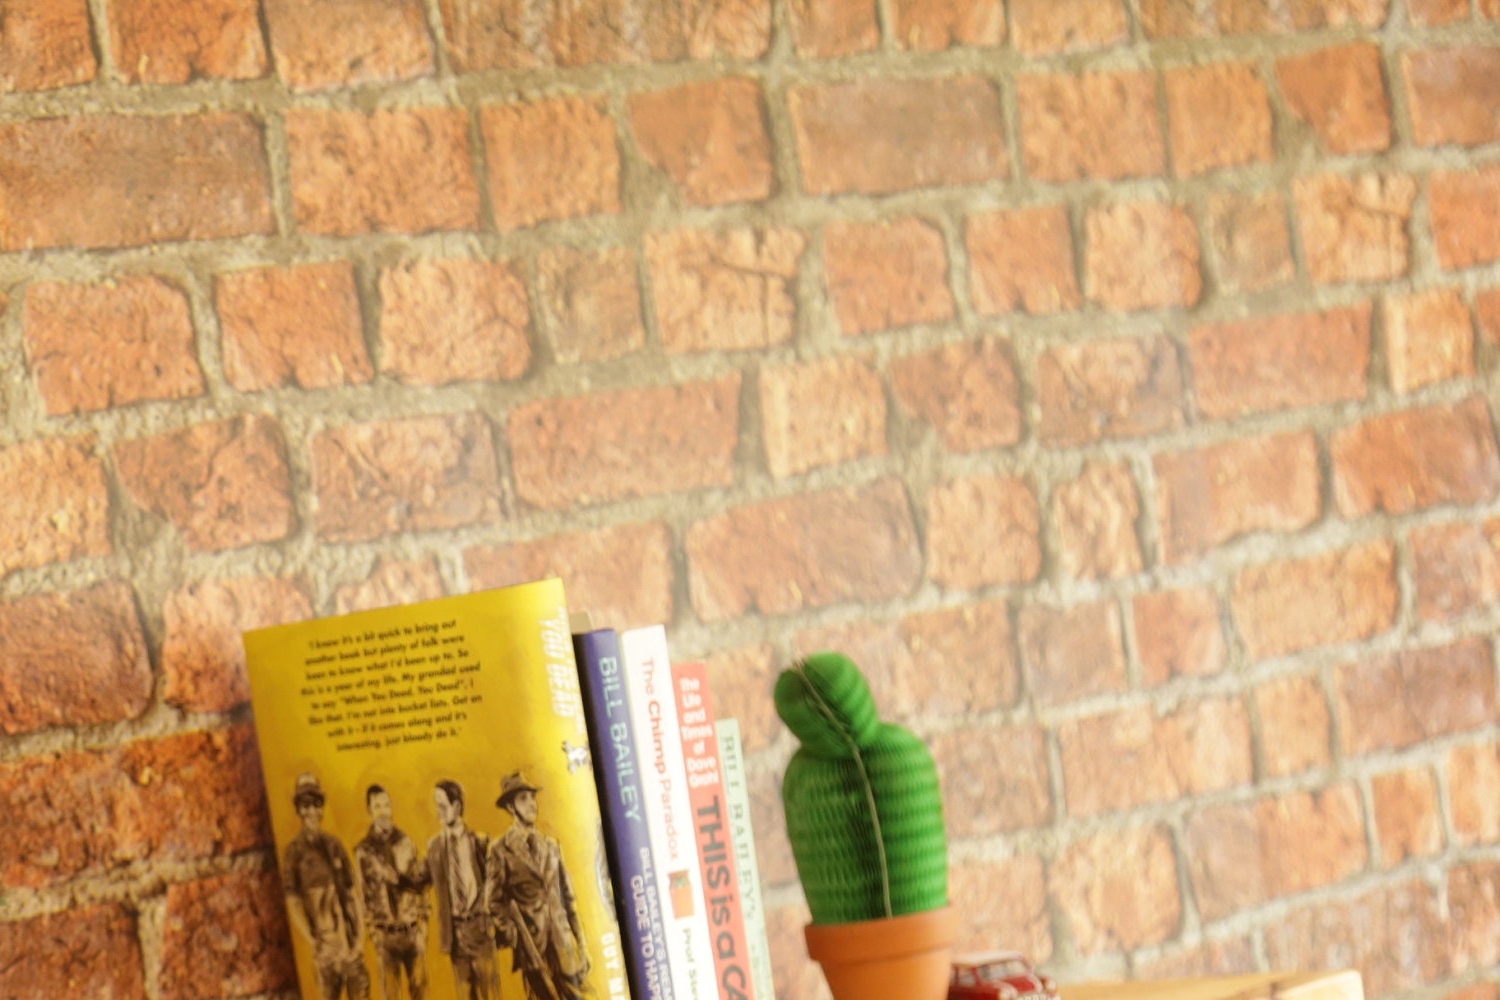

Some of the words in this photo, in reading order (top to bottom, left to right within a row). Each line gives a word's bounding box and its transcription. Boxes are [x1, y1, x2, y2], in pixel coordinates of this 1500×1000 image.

[363, 631, 375, 641] bit
[377, 627, 401, 641] quick
[414, 621, 439, 635] bring
[441, 618, 456, 629] out
[339, 649, 360, 660] book
[363, 647, 377, 656] but
[380, 642, 407, 656] plenty
[421, 637, 438, 647] folk
[441, 635, 465, 644] were
[339, 665, 363, 676] know
[366, 661, 388, 672] what
[404, 655, 426, 665] been
[458, 661, 481, 672] used
[371, 691, 386, 702] You
[417, 684, 433, 694] You
[599, 656, 623, 718] BILL
[680, 677, 700, 692] The
[682, 693, 702, 708] Life
[407, 714, 433, 728] along
[434, 711, 452, 722] and
[683, 707, 706, 724] and
[402, 730, 433, 745] bloody
[681, 724, 713, 741] Times
[693, 740, 706, 755] of
[641, 657, 655, 696] The
[648, 700, 668, 775] Chimp
[660, 779, 679, 861] Paradox
[687, 756, 717, 773] Dave
[610, 721, 641, 822] BAILEY
[688, 769, 720, 788] Grohl
[697, 796, 731, 890] THIS
[640, 847, 656, 882] BILL
[630, 875, 650, 930] GUIDE
[640, 933, 655, 960] TO
[711, 894, 733, 927] is
[601, 931, 621, 969] GUY
[682, 927, 696, 964] Prof
[716, 931, 736, 960] a
